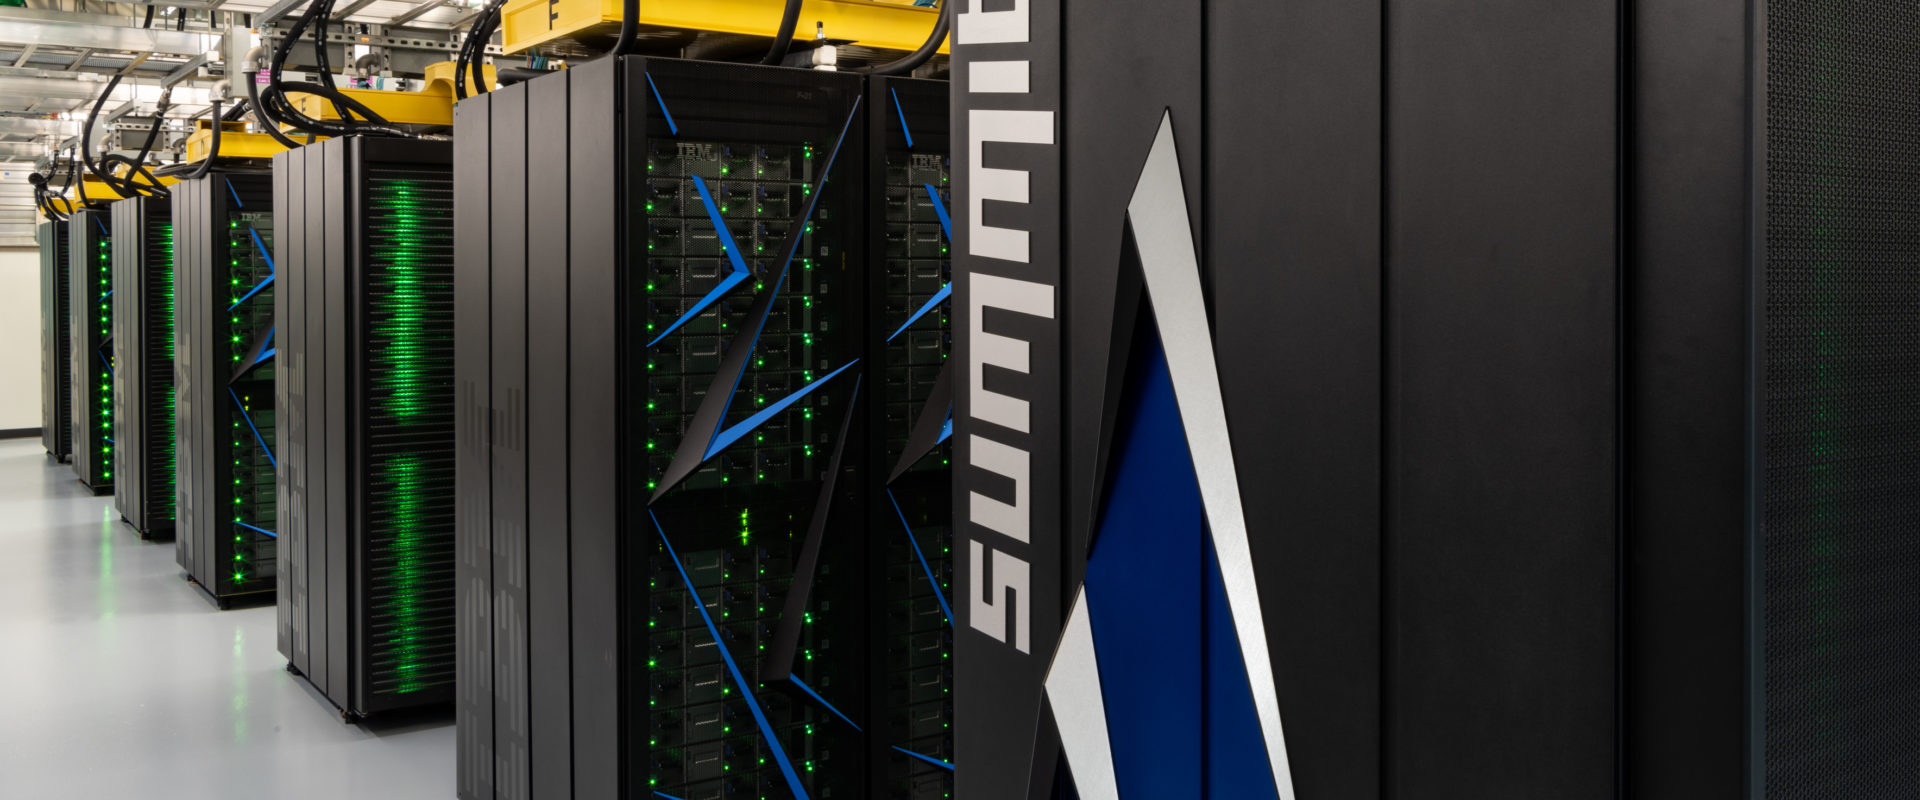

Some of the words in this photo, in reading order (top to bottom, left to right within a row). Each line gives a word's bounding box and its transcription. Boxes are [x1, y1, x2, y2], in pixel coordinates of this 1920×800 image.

[549, 0, 559, 30] F
[676, 142, 713, 160] IBM
[912, 154, 942, 171] IBM
